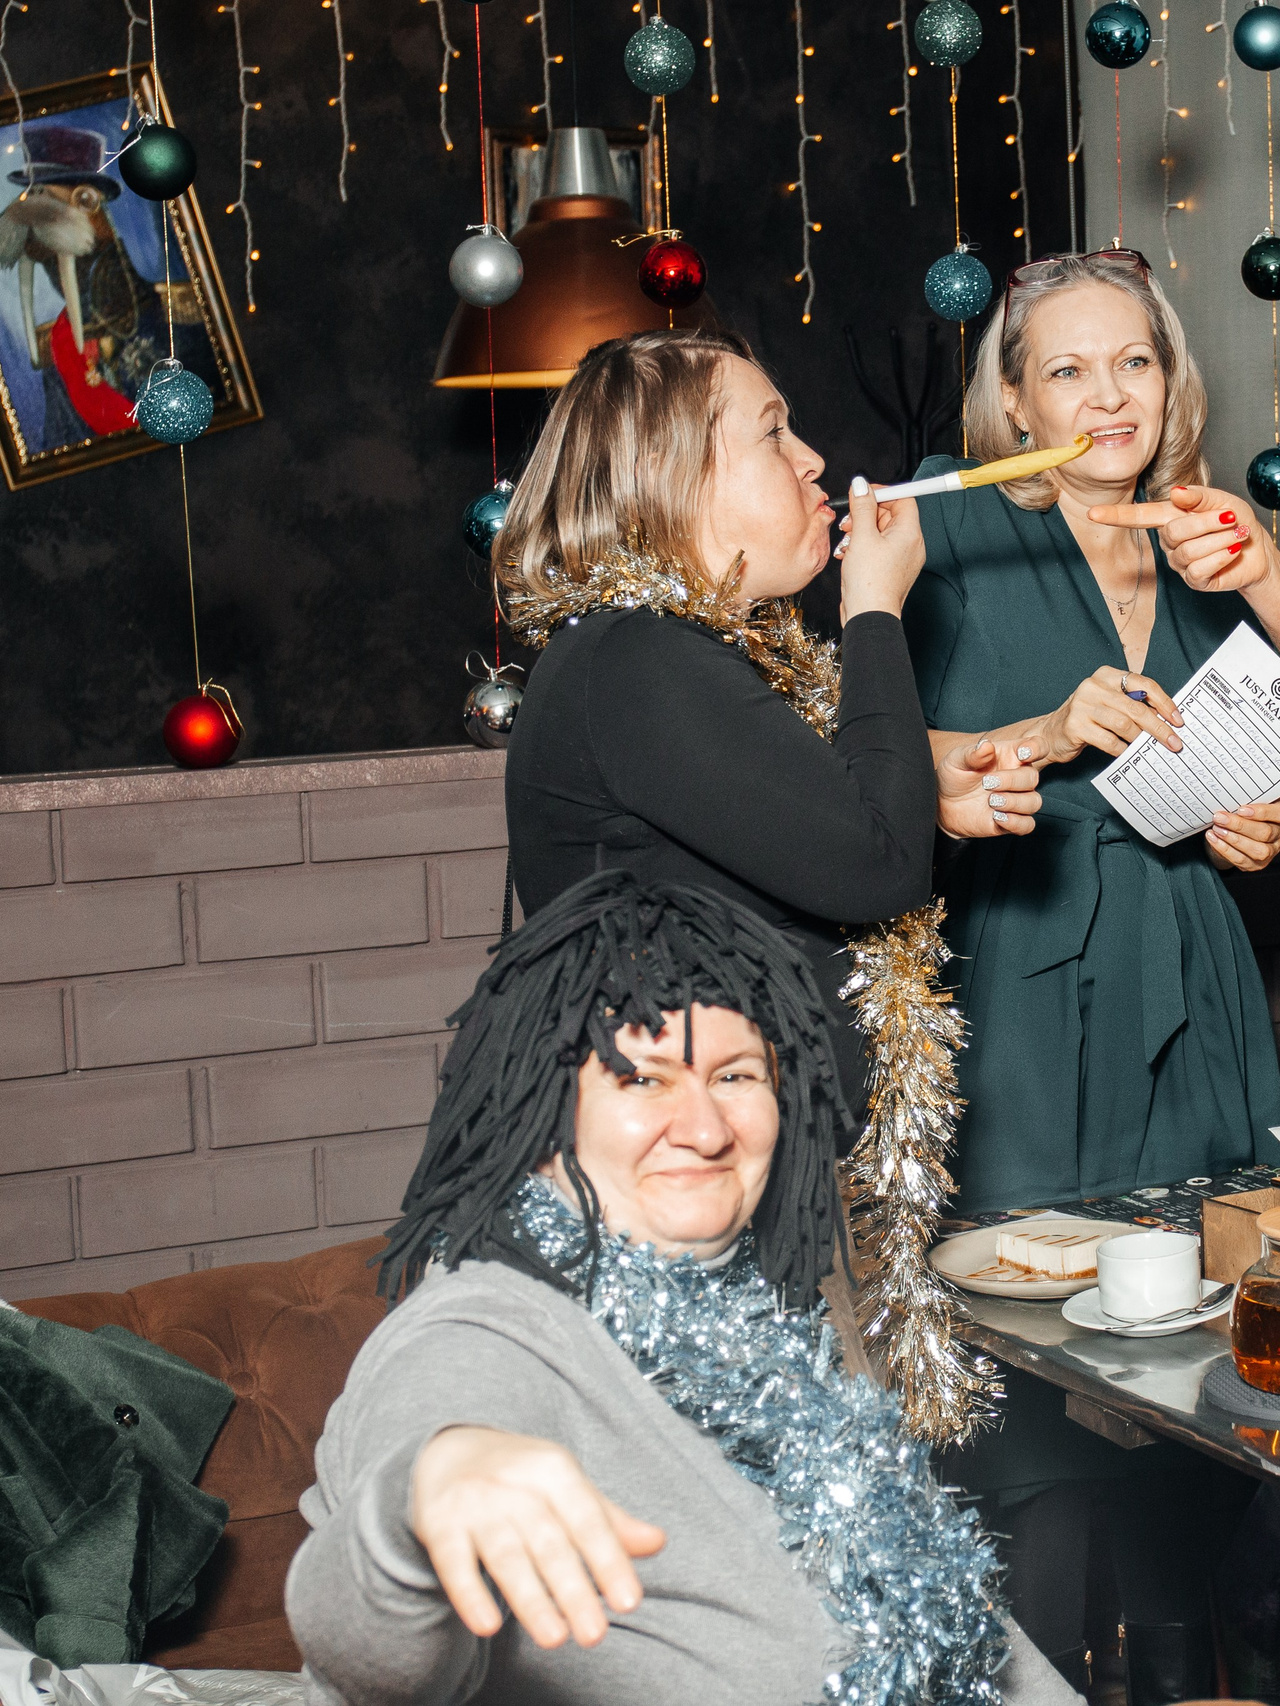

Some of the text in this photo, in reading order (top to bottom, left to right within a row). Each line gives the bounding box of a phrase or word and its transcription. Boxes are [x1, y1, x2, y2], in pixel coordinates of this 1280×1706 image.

[1239, 675, 1267, 699] JUST
[1194, 689, 1201, 698] 1.
[1186, 698, 1194, 708] 2.
[1263, 710, 1275, 723] QUIZ
[1142, 745, 1151, 756] 7.
[1132, 756, 1141, 766] 8.
[1122, 765, 1130, 775] 9.
[1111, 774, 1121, 785] 10.
